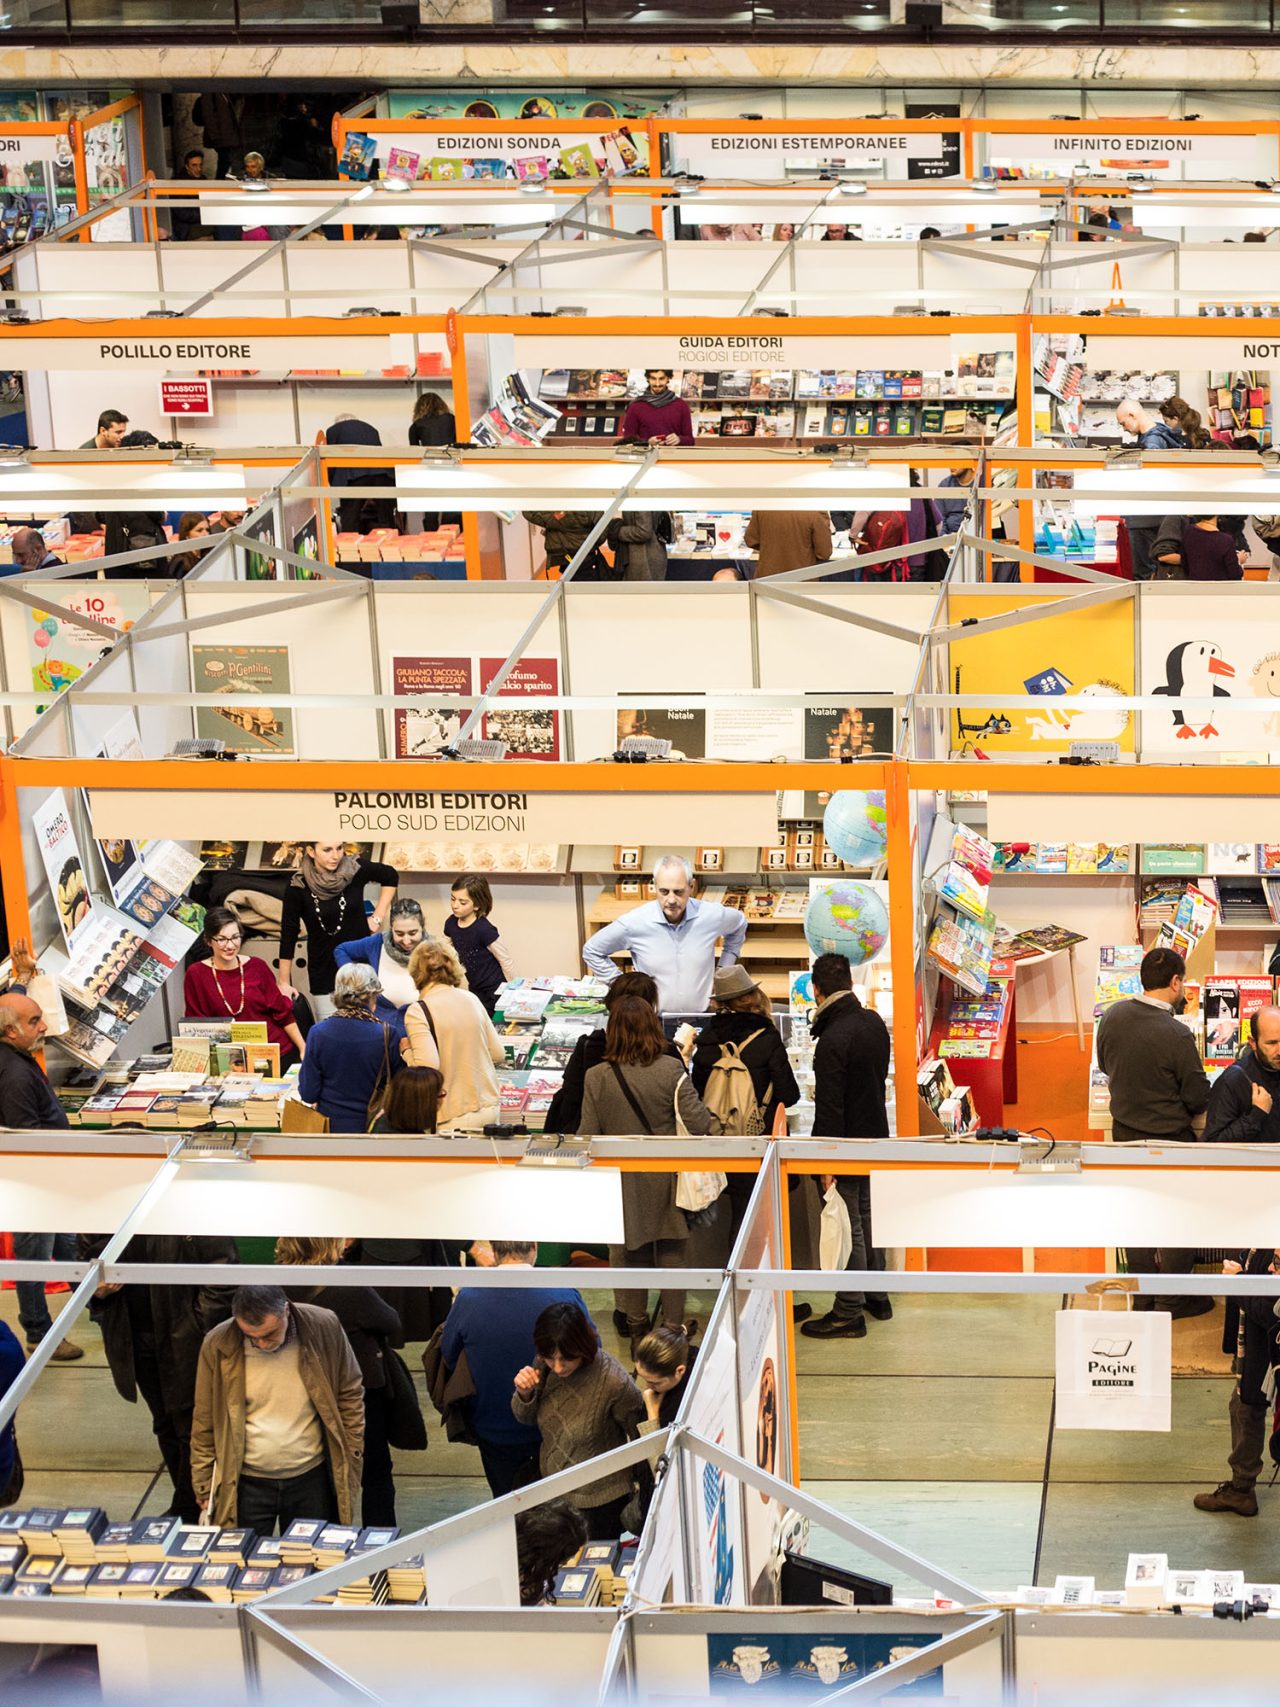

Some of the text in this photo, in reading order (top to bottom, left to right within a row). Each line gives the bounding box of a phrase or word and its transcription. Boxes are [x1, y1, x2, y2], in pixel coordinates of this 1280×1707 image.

[437, 138, 562, 149] EDIZIONI SONDA
[710, 138, 908, 150] EDIZIONI ESTEMPORANEE
[1054, 139, 1192, 151] INFINITO EDIZIONI
[680, 336, 783, 348] GUIDA EDITORI
[100, 344, 251, 358] POLILLO EDITORE
[679, 350, 785, 362] ROGIOSI EDITORE
[168, 385, 206, 393] BASSOTTI
[70, 598, 105, 613] Le 10
[396, 668, 468, 677] GIULIANO TACCOLA:
[505, 669, 538, 680] rofumo
[398, 676, 466, 684] LA PUNTA SPEZZATA
[500, 680, 553, 692] alcio sparito
[667, 712, 695, 720] Natale
[810, 707, 838, 716] Natale
[334, 792, 528, 810] PALOMBI EDITORI
[339, 813, 526, 832] POLO SUD EDIZIONI
